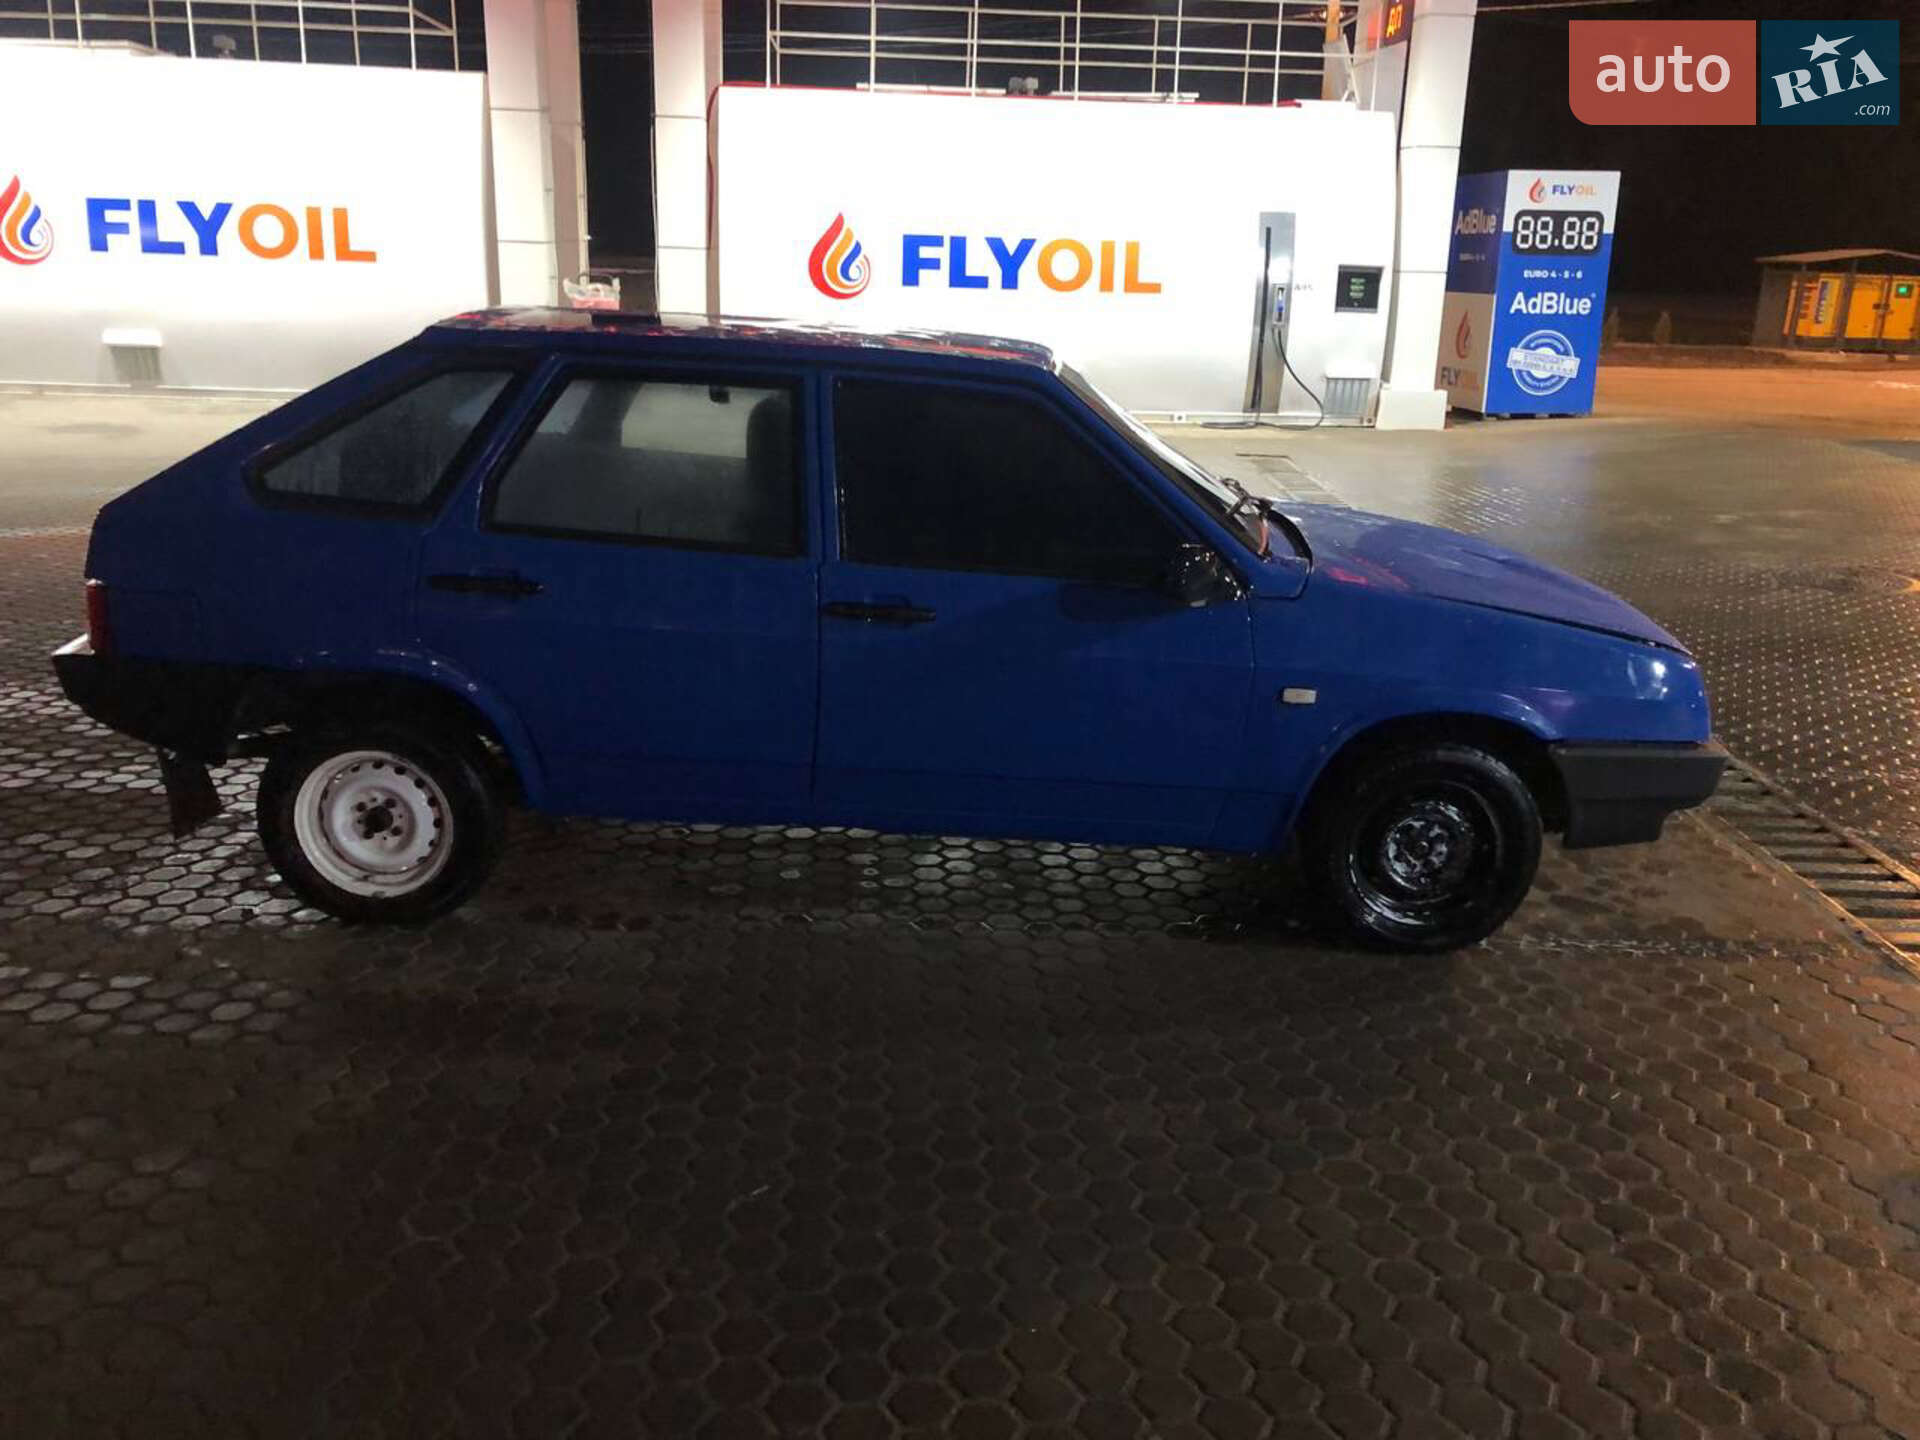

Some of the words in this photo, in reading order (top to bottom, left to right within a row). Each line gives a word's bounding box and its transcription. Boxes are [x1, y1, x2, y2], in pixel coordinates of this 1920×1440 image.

[1552, 184, 1598, 196] FLYOIL
[86, 197, 377, 263] FLYOIL
[1455, 208, 1497, 235] AdBlue
[1516, 215, 1600, 250] 88.88
[902, 234, 1162, 294] FLYOIL
[1509, 291, 1592, 315] AdBlue
